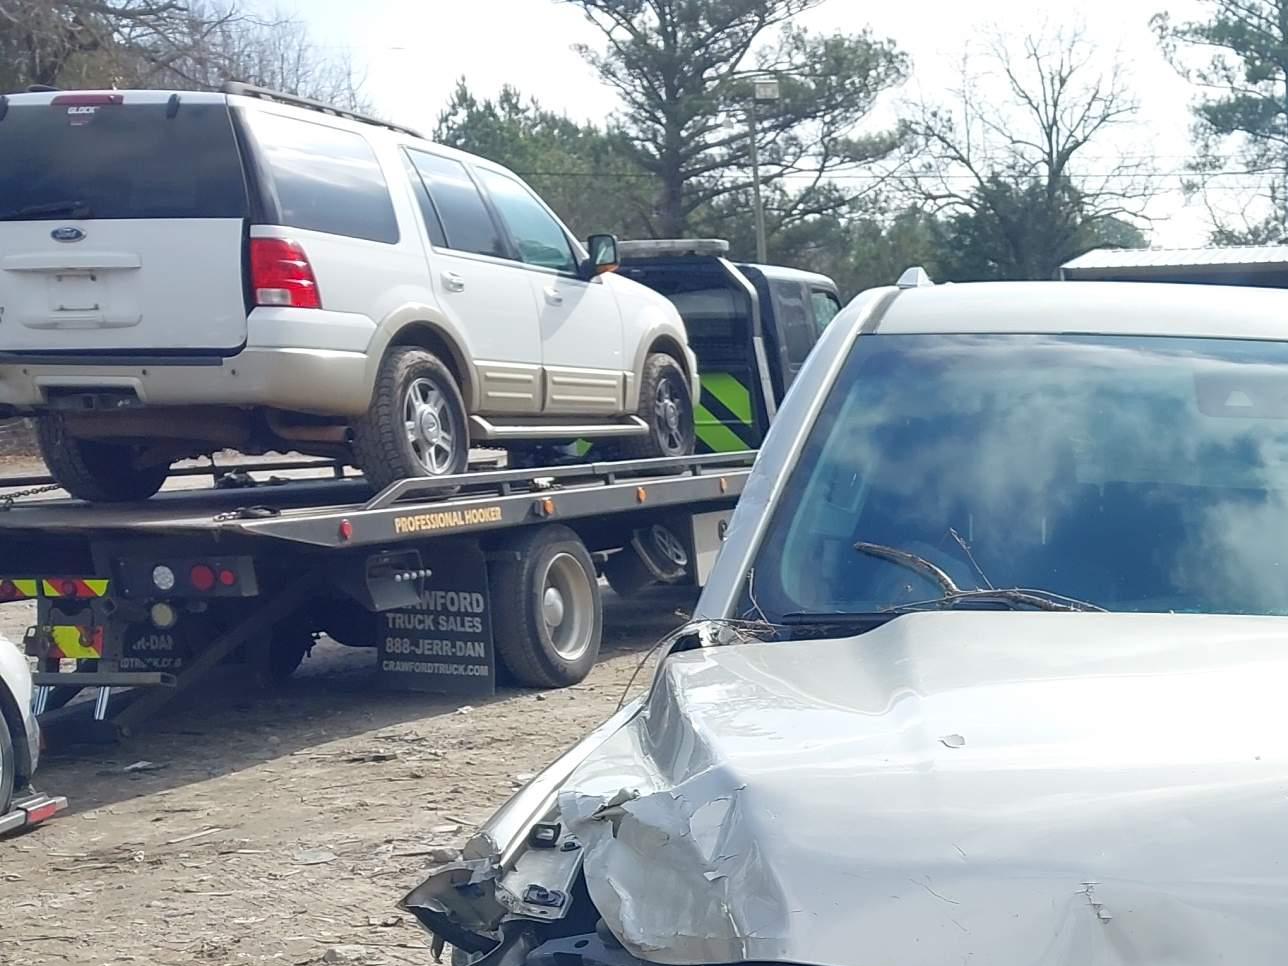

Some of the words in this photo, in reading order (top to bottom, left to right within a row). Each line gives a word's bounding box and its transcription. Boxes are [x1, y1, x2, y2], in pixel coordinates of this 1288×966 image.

[394, 511, 464, 533] PROFESSIONAL
[465, 506, 502, 524] HOOKER
[402, 590, 485, 613] WFORD
[385, 613, 435, 631] TRUCK
[438, 615, 483, 633] SALES
[385, 637, 486, 658] 888-JERR-DAN
[382, 660, 489, 677] CRAWFORDTRUCK.COM
